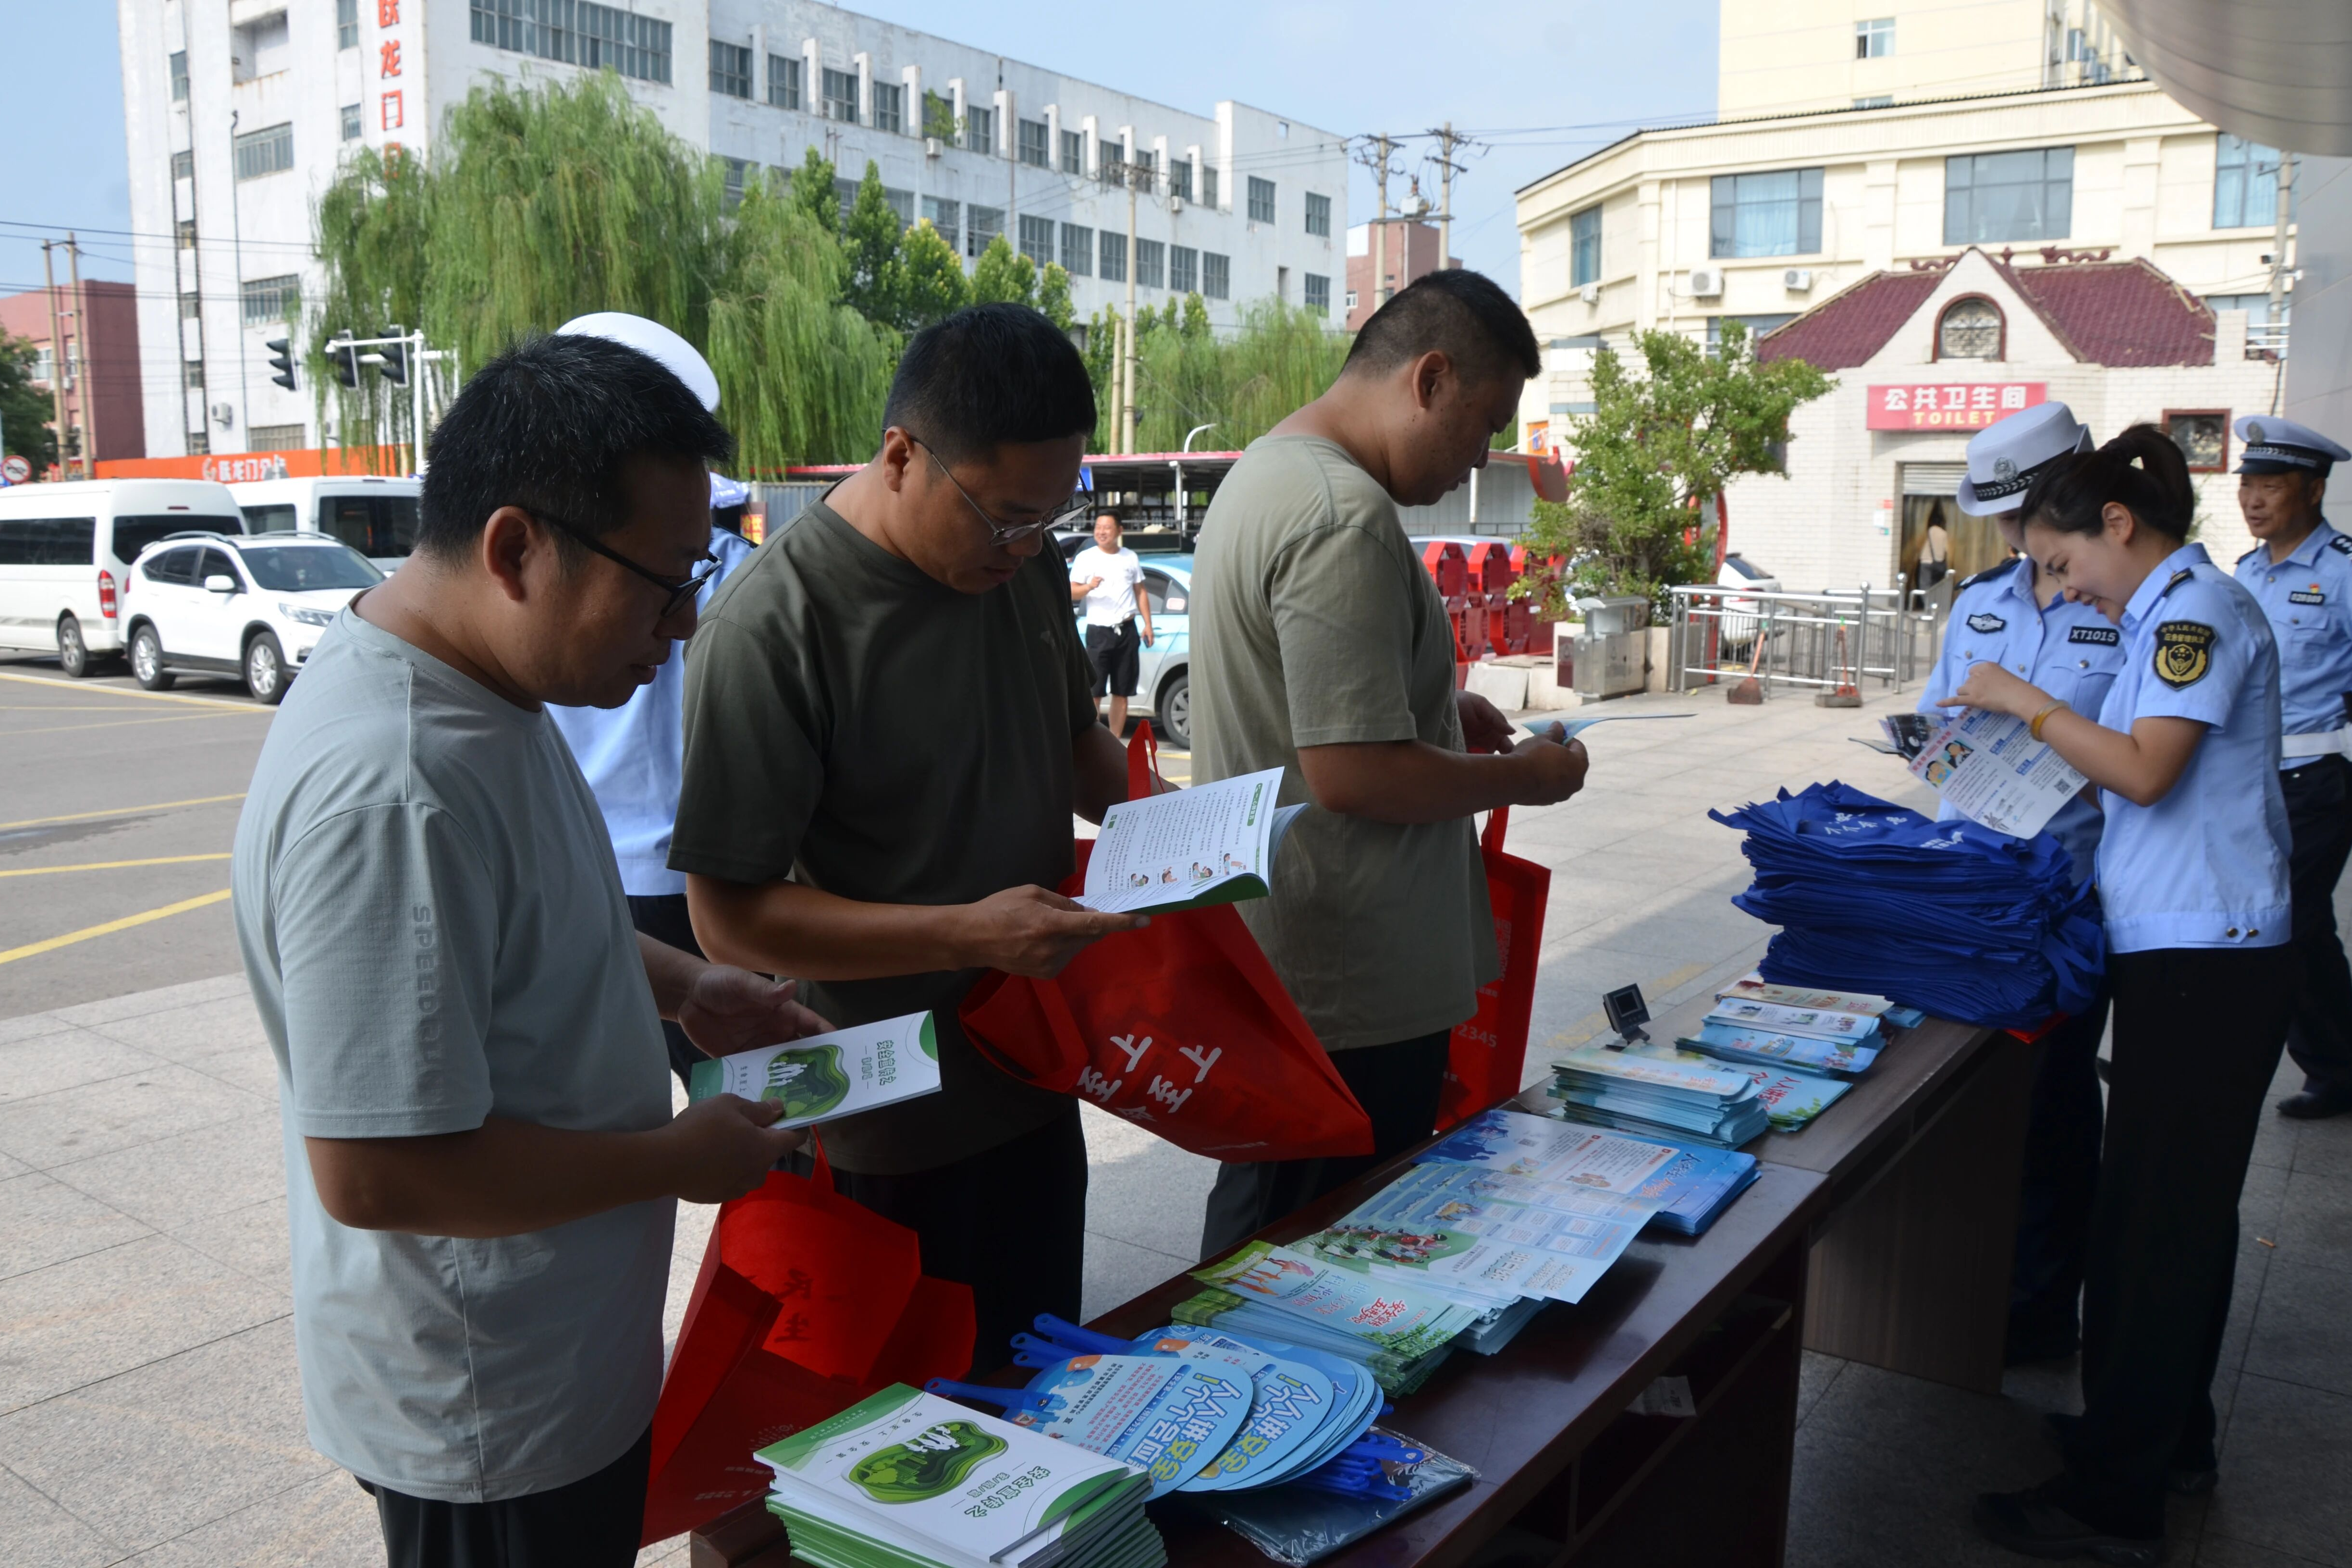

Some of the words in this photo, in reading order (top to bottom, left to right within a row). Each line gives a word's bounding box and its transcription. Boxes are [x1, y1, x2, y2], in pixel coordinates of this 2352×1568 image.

[1884, 386, 2026, 410] 公共卫生间
[1913, 411, 1996, 425] TOILET
[2070, 629, 2117, 643] XT1015
[2161, 625, 2211, 637] 中华人民共和国
[878, 1041, 896, 1085] 安全宣传之
[1077, 1034, 1152, 1102] 至上
[1366, 1300, 1406, 1327] 安全宣传
[878, 1412, 922, 1435] 生命至上
[1062, 1415, 1073, 1425] 宣
[1148, 1380, 1242, 1482] 人人讲安全
[1215, 1383, 1321, 1476] 人人讲安全
[825, 1443, 870, 1462] 安全第一
[964, 1466, 1051, 1516] 安全宣传之
